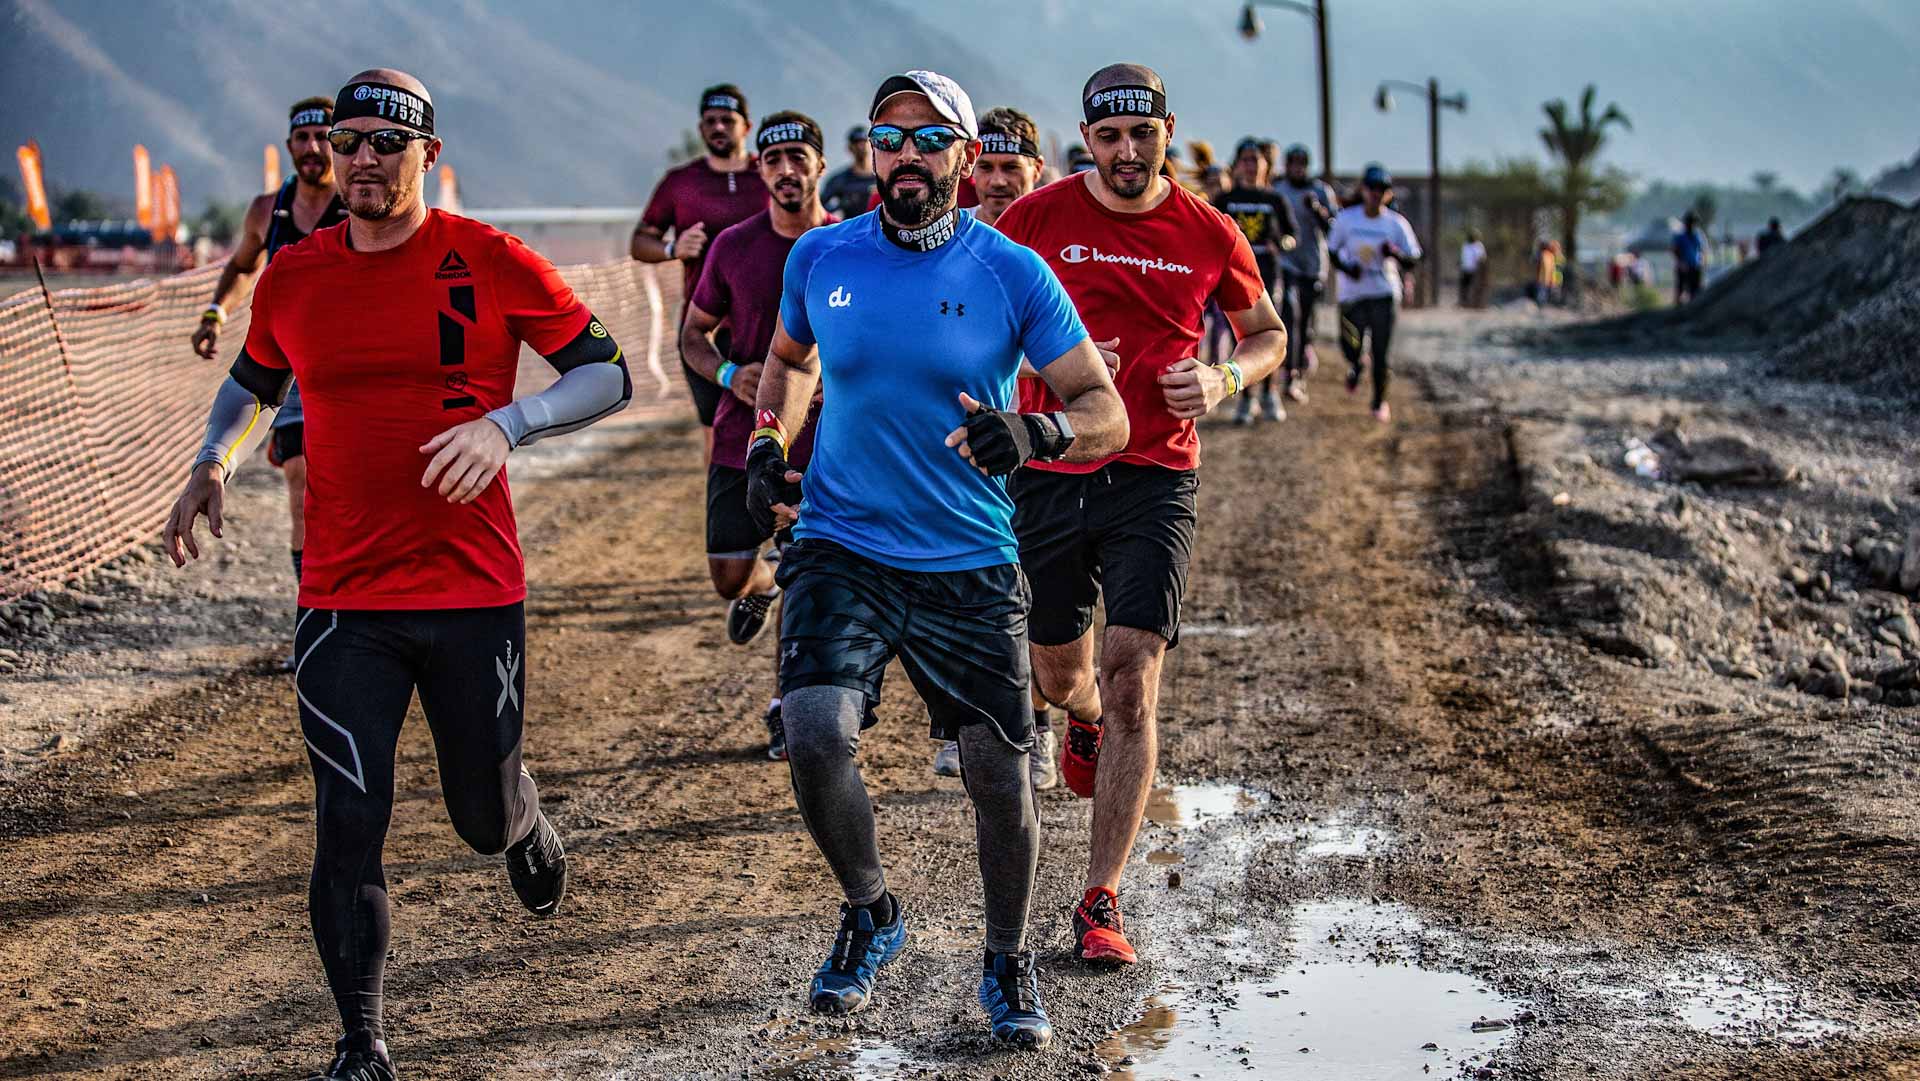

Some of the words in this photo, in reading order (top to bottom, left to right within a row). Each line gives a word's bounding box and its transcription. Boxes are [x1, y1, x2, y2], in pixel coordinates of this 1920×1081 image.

[372, 87, 424, 113] SPARTAN
[1104, 89, 1153, 103] SPARTAN
[1108, 99, 1152, 114] 17860
[377, 101, 423, 127] 17526
[913, 211, 954, 241] SPARTAN
[918, 223, 955, 252] 15251
[1060, 244, 1193, 275] Champion
